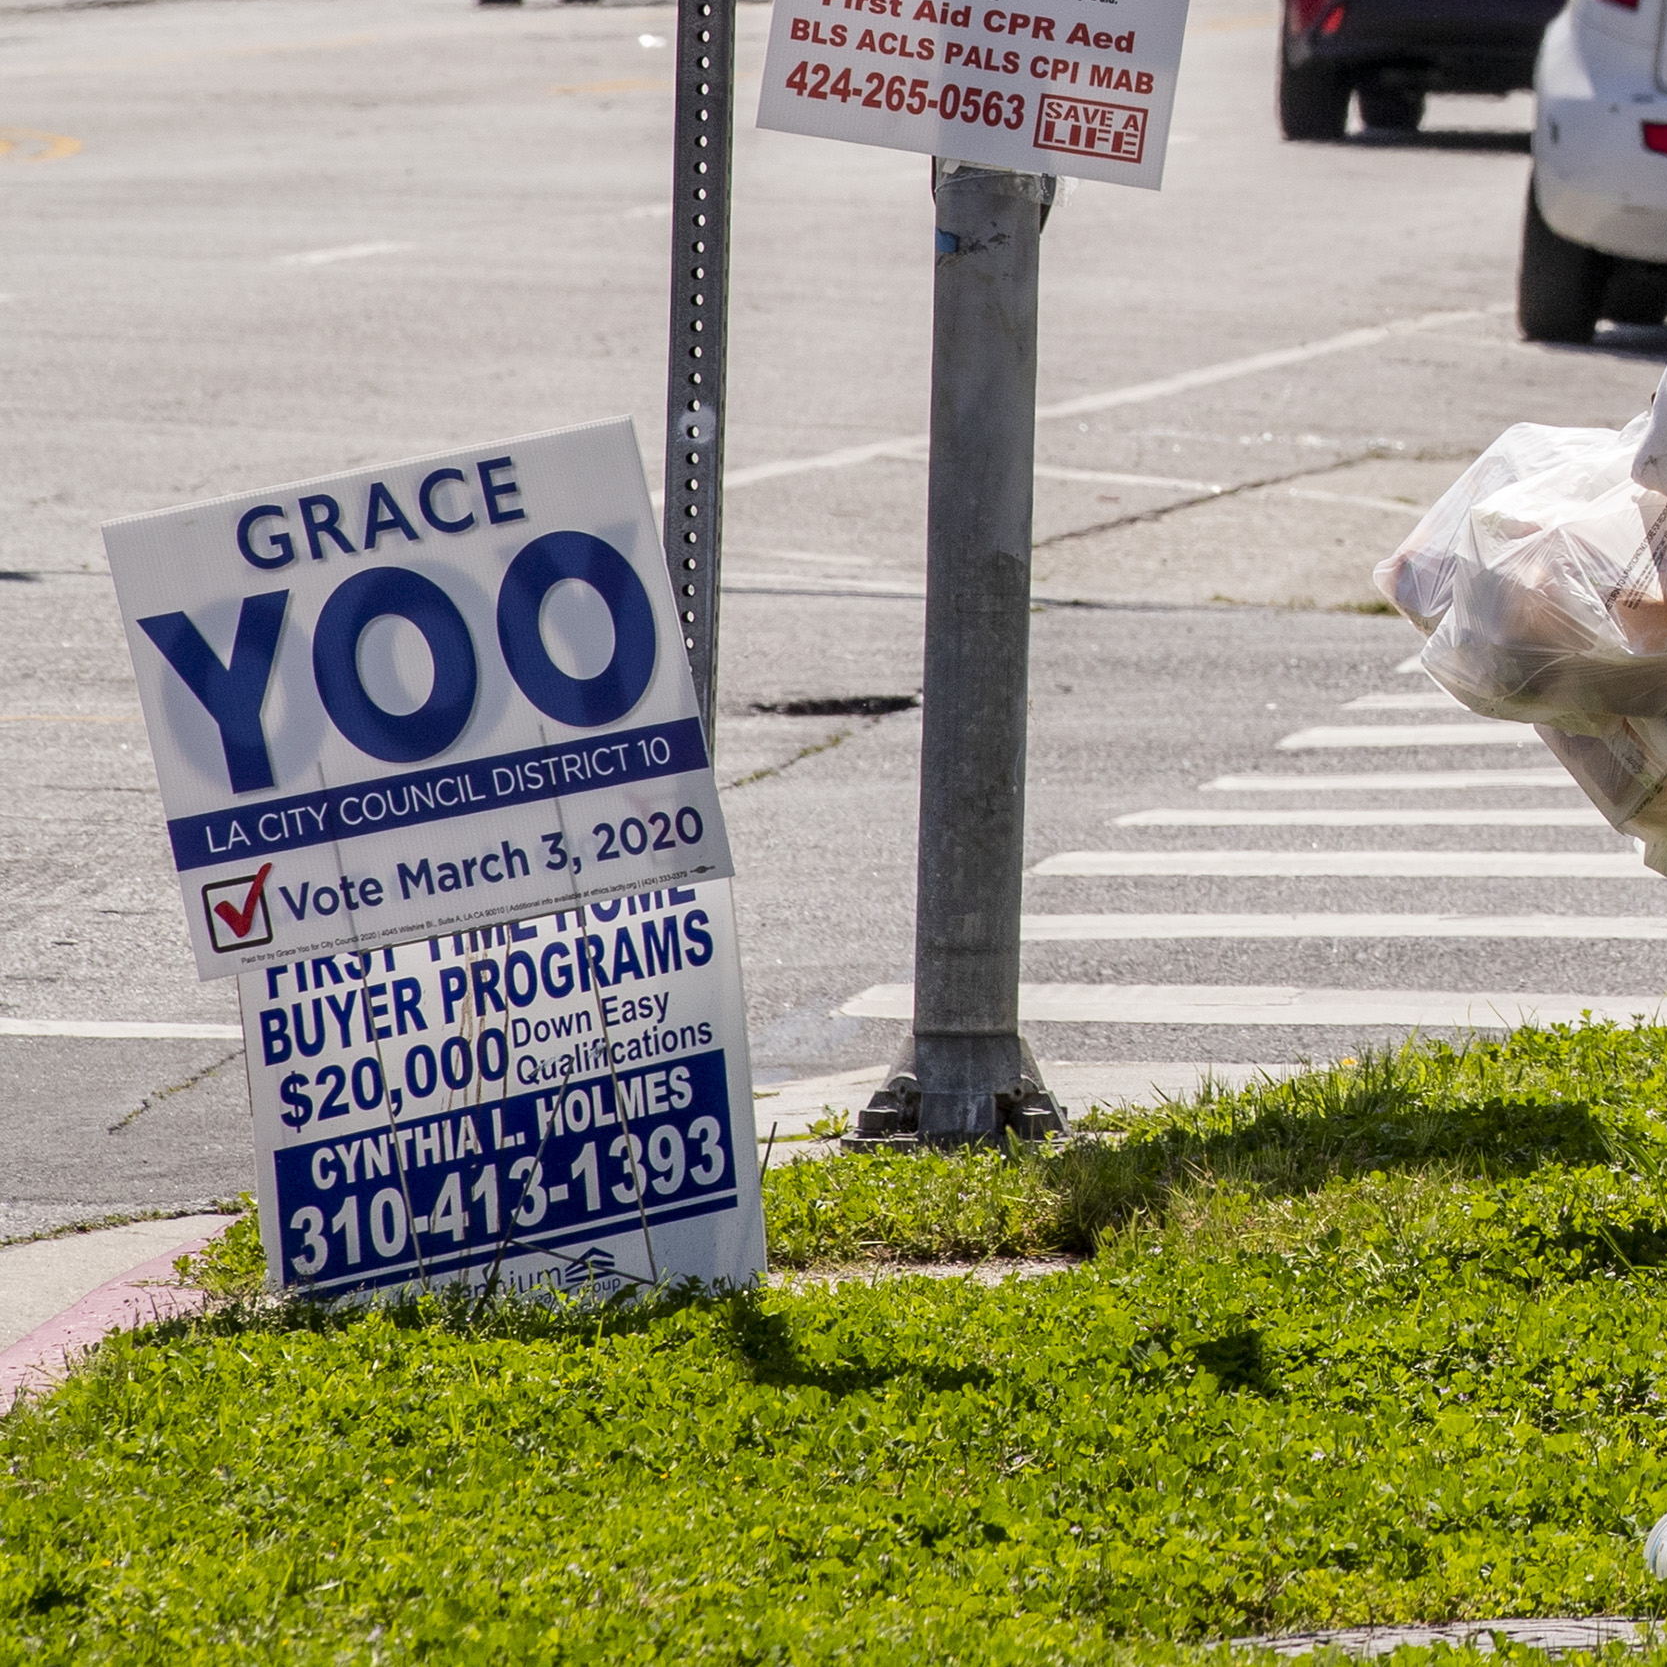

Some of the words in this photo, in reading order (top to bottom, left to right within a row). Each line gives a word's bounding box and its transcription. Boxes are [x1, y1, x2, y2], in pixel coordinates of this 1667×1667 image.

[790, 17, 849, 48] BLS
[855, 29, 936, 61] ACLS
[944, 41, 1021, 76] PALS
[1029, 55, 1080, 85] CPI
[1088, 65, 1155, 96] MAB
[912, 0, 972, 29] Aid
[982, 8, 1056, 42] CPR
[1066, 21, 1136, 54] Aed
[785, 60, 1026, 132] 424-265-0563
[1043, 121, 1139, 157] LIFE
[1045, 101, 1115, 130] SAVE
[1122, 111, 1140, 132] A
[235, 455, 526, 572] GRACE
[136, 530, 657, 796] YOO
[205, 824, 251, 854] LA
[258, 801, 330, 843] CITY
[337, 772, 486, 827] COUNCIL
[491, 745, 630, 798] DISTRICT
[636, 735, 672, 767] 10
[278, 875, 384, 922] Vote
[396, 838, 532, 900] March
[545, 831, 584, 875] 3,
[589, 804, 704, 862] 2020
[241, 956, 256, 965] Paid
[257, 952, 267, 963] for
[266, 951, 276, 962] by
[276, 947, 297, 958] Grace
[297, 944, 310, 955] Yoo
[310, 941, 320, 952] for
[320, 939, 335, 951] City
[334, 935, 360, 948] Council
[360, 931, 378, 942] 2020
[399, 920, 426, 934] Wilshire
[437, 915, 455, 927] Suite
[463, 911, 474, 921] LA
[474, 908, 485, 919] CA
[509, 899, 541, 913] Additional
[541, 897, 554, 907] info
[553, 891, 582, 905] available
[582, 889, 590, 899] at
[590, 880, 639, 898] ethics.lacity.org
[257, 975, 428, 1067] BUYER
[439, 908, 715, 1026] PROGRAMS
[510, 1001, 592, 1050] Down
[600, 989, 672, 1030] Easy
[278, 1026, 510, 1135] $20,000
[516, 1020, 715, 1087] Qualifications
[311, 1112, 484, 1191] CYNTHIA
[492, 1106, 527, 1151] L.
[535, 1064, 694, 1139] HOLMES
[290, 1114, 727, 1276] 310-413-1393
